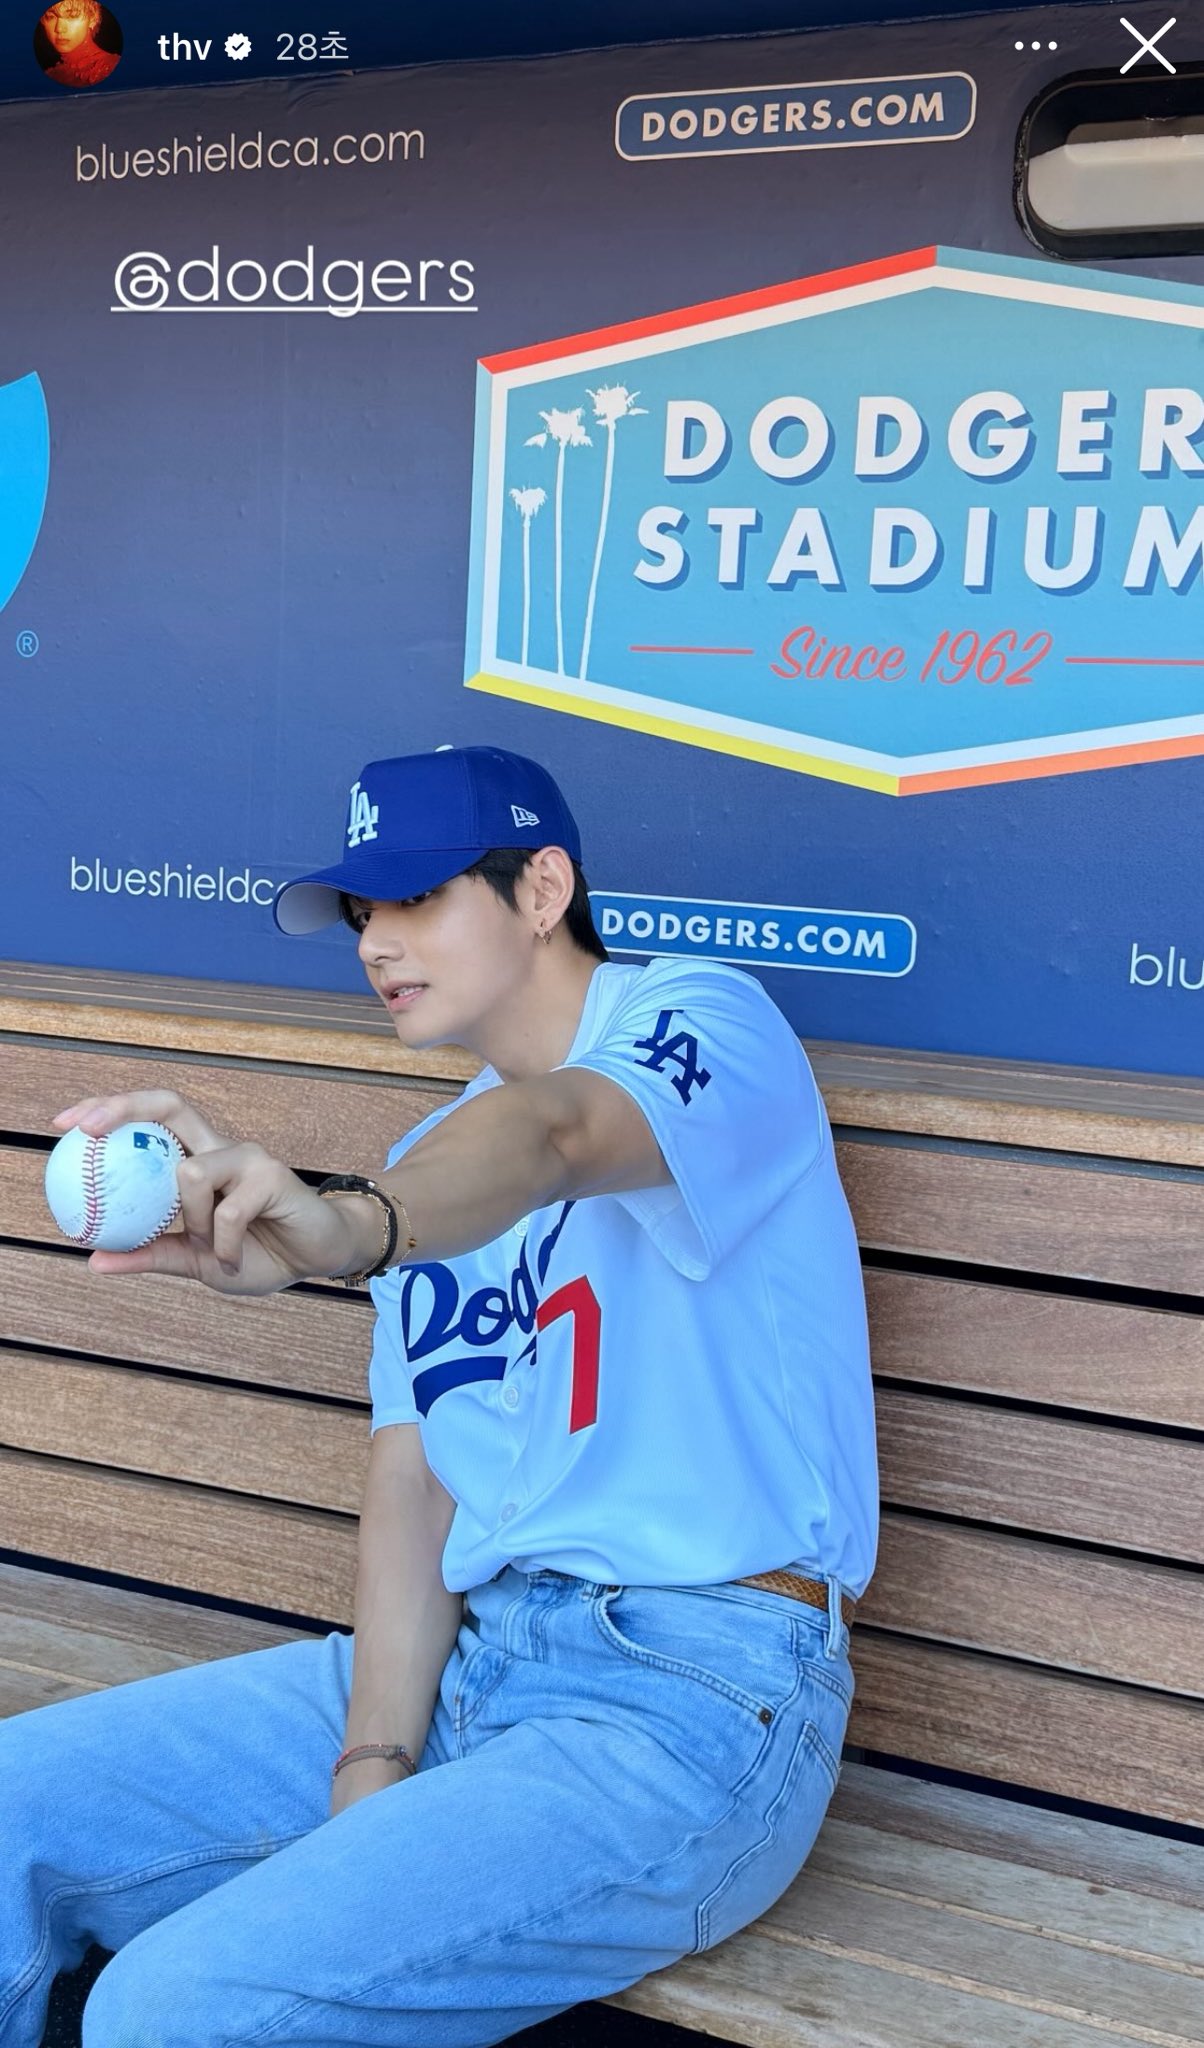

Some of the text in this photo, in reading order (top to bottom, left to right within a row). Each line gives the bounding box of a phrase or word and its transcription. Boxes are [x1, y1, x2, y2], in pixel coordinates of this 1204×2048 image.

[641, 91, 946, 143] DODGERS.COM
[75, 128, 426, 183] blueshieldca.com
[663, 388, 1204, 485] DODGER
[632, 505, 1204, 596] STADIUM
[769, 625, 1055, 688] Since 1962
[347, 781, 379, 848] LA
[70, 856, 289, 906] blueshieldc
[601, 907, 887, 960] DODGERS.COM
[632, 1008, 712, 1107] LA
[536, 1274, 602, 1434] 7
